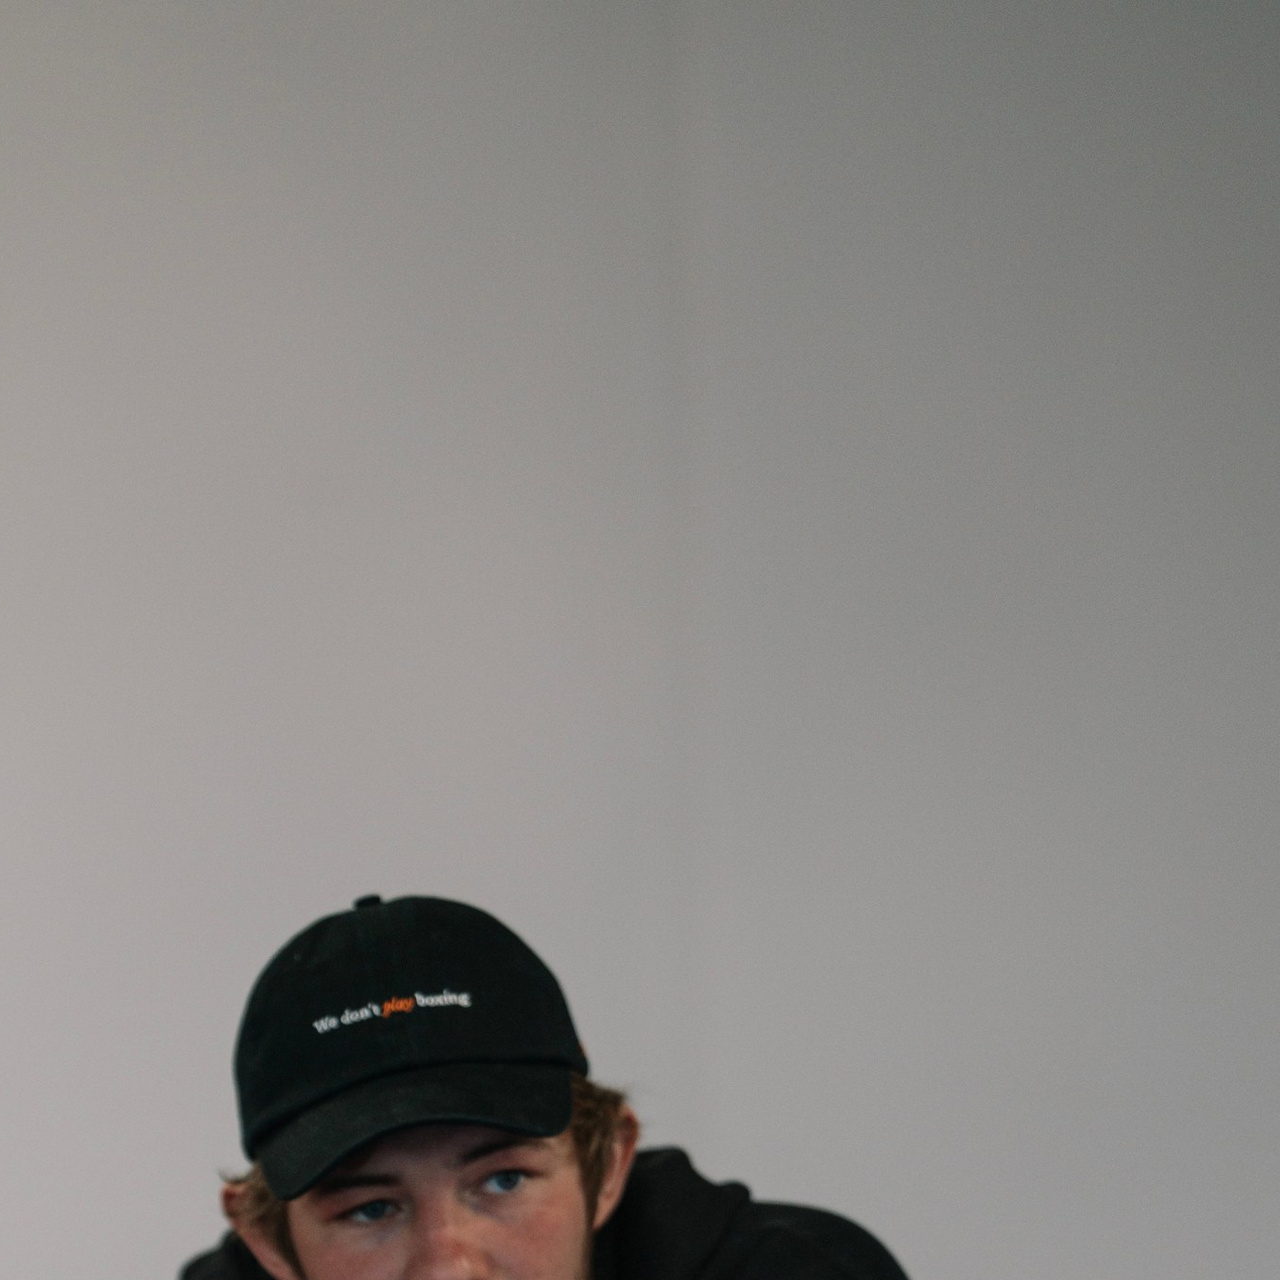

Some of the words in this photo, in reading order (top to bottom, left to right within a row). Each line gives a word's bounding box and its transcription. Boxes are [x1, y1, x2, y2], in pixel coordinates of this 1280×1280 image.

[313, 1015, 340, 1034] We
[340, 1002, 381, 1026] don't
[381, 996, 415, 1018] play
[414, 989, 471, 1008] boxing
